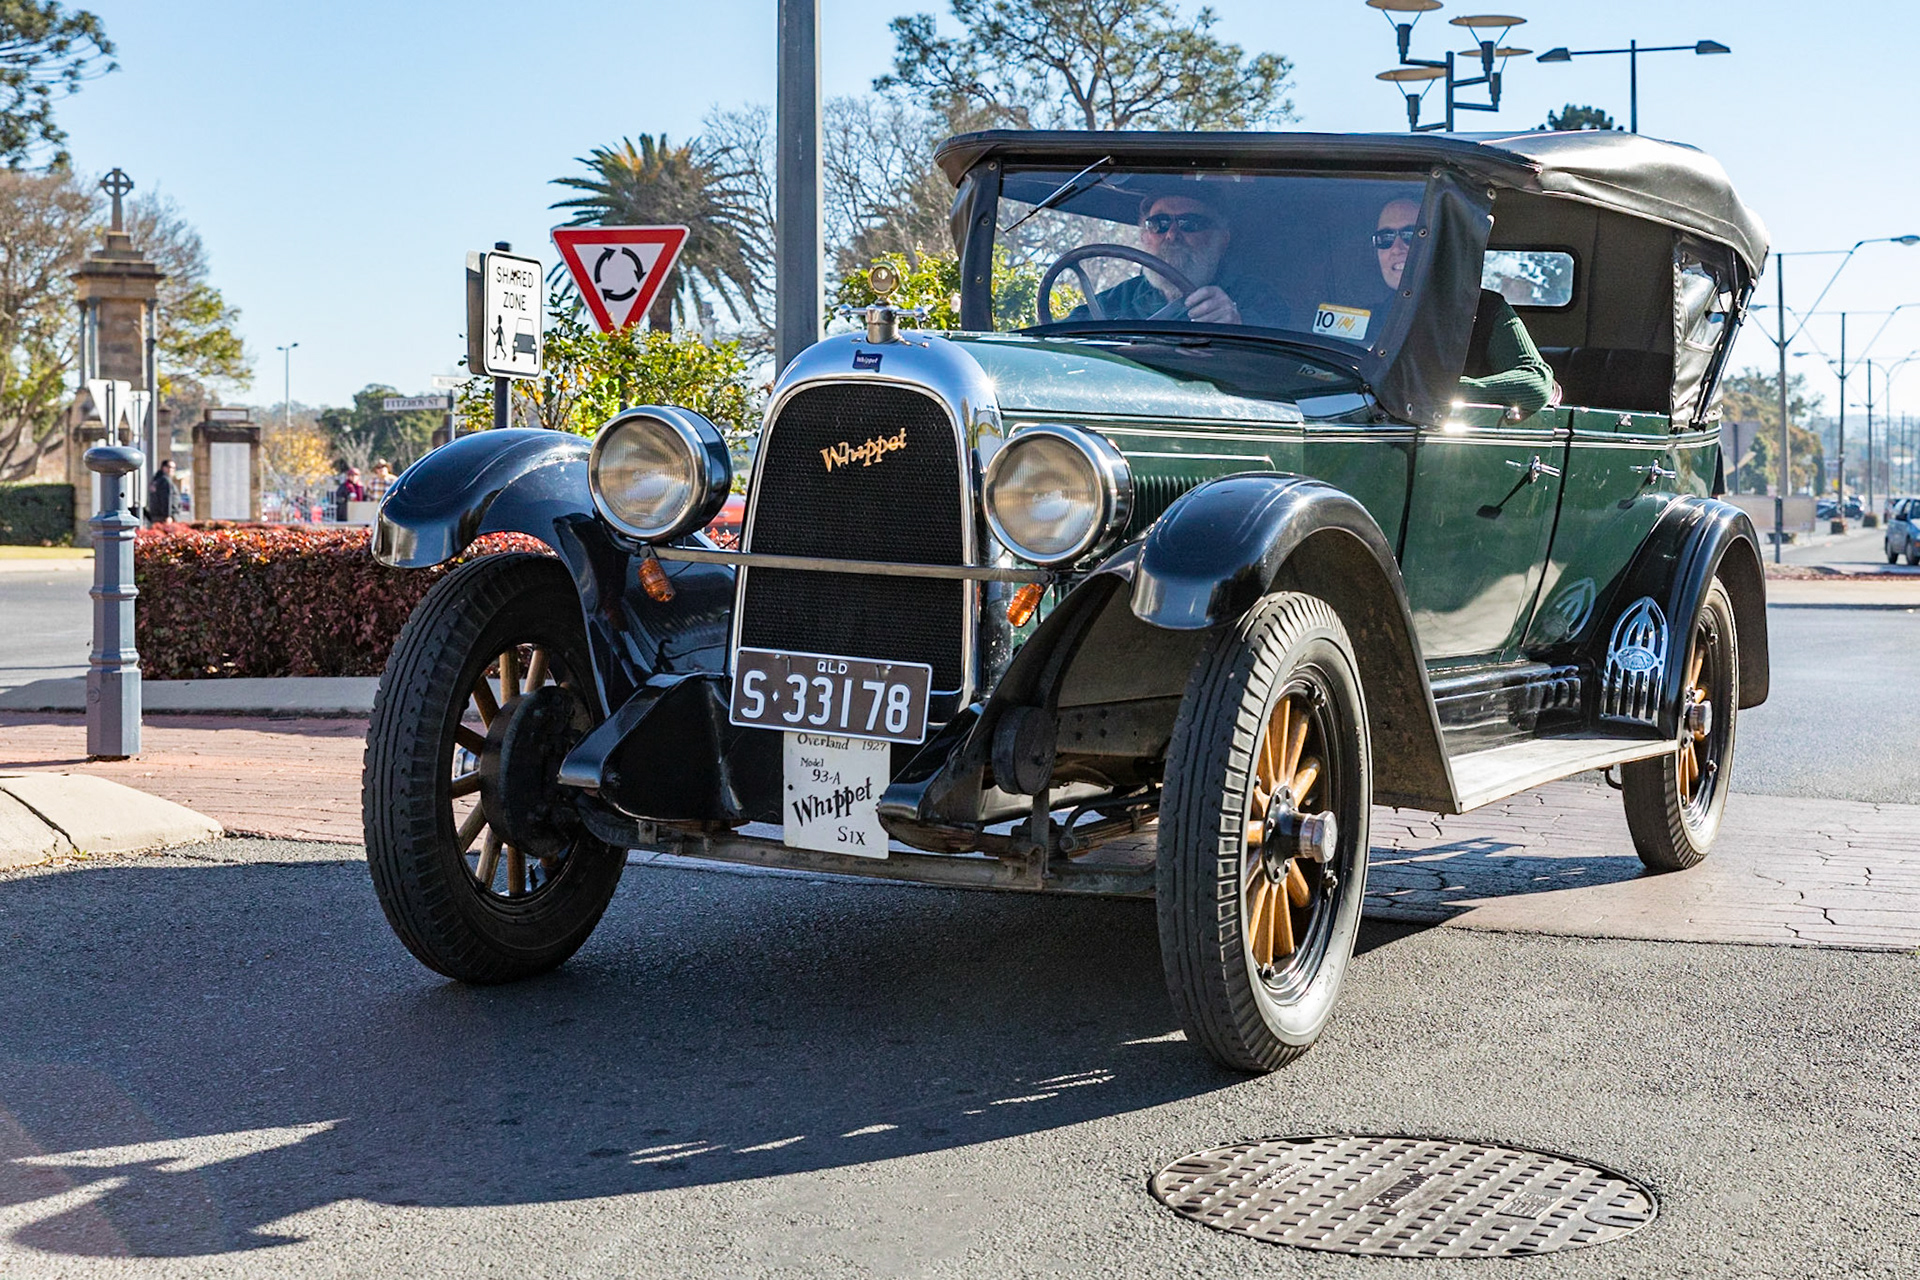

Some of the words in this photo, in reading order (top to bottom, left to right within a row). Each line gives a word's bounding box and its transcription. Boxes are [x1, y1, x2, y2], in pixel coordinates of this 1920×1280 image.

[496, 266, 534, 288] SHARED
[503, 291, 527, 311] ZONE
[1316, 310, 1335, 328] 10
[856, 356, 878, 364] Whippet
[385, 399, 425, 409] FITZROY
[427, 398, 439, 407] ST
[820, 427, 907, 473] Whippet
[816, 660, 849, 675] QLD
[797, 732, 850, 751] Overland
[861, 741, 888, 752] 1927
[800, 757, 824, 768] Model
[811, 768, 841, 786] 93-A
[792, 776, 873, 827] Whippet
